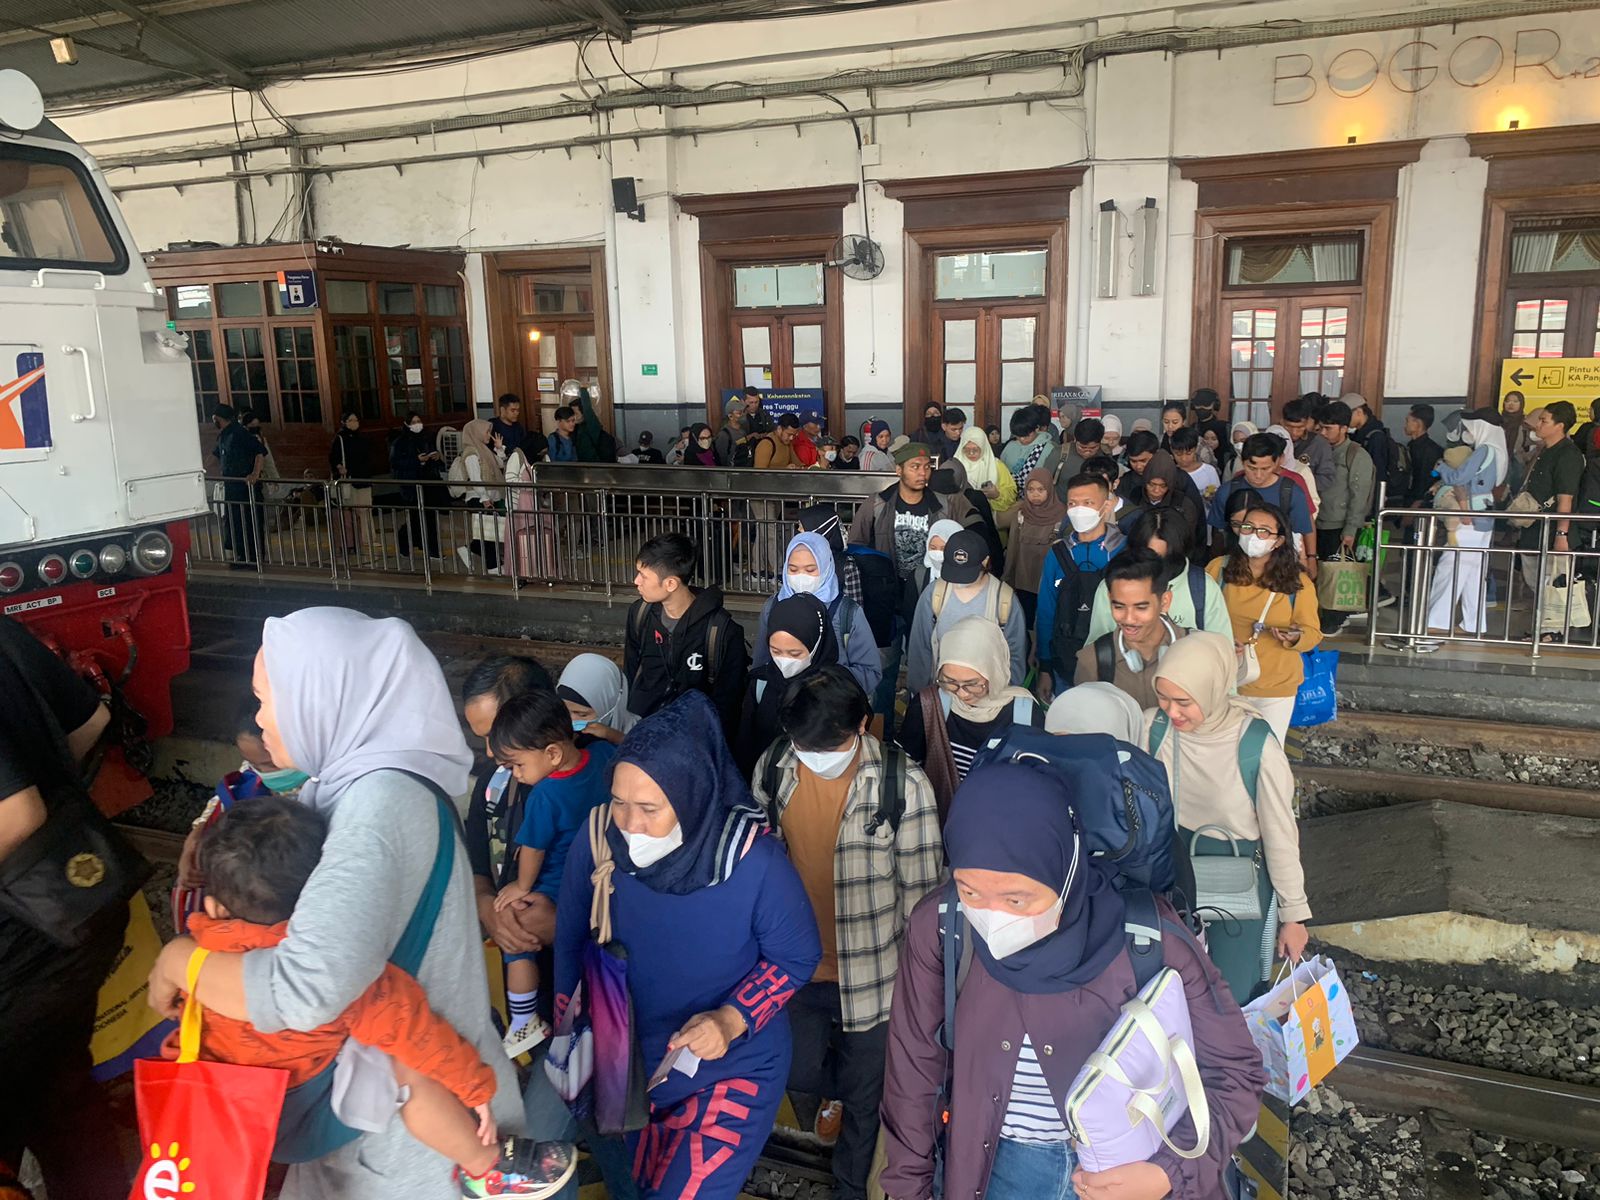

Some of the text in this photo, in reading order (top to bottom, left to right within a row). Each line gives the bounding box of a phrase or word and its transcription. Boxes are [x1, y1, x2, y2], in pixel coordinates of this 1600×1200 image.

[1273, 28, 1561, 106] BOGOR
[1583, 374, 1600, 382] Pan
[774, 402, 799, 411] Tunggu
[6, 604, 22, 613] MRE
[26, 600, 41, 609] ACT
